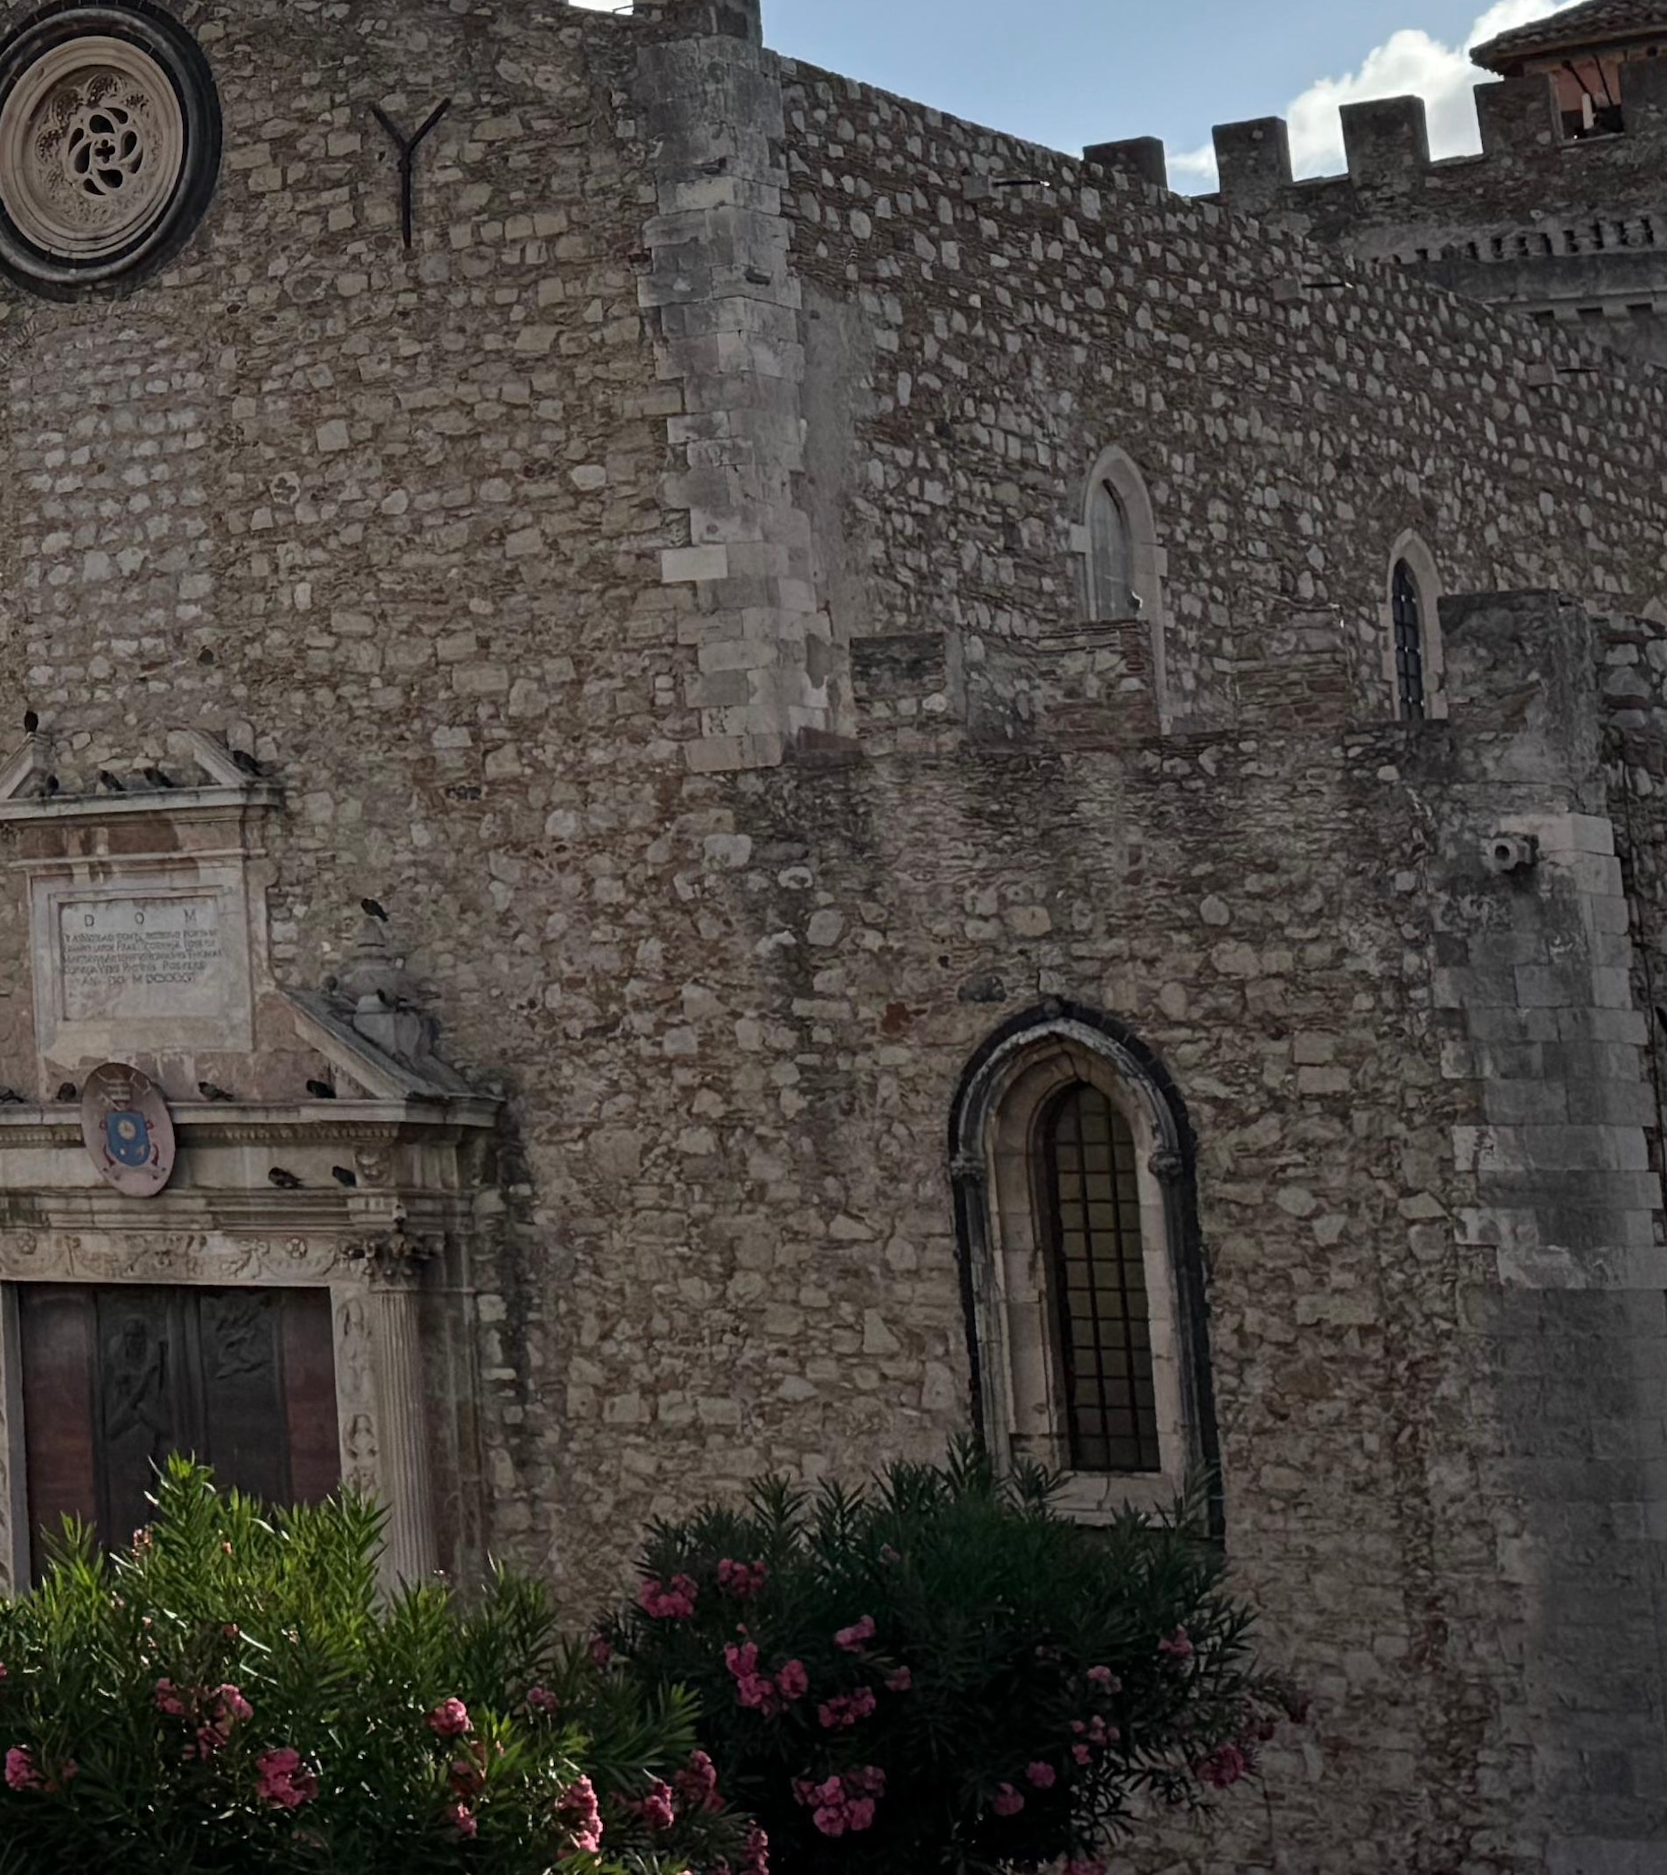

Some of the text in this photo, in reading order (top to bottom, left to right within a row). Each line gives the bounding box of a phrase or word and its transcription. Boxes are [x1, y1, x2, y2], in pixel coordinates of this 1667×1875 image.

[84, 909, 197, 927] D O M
